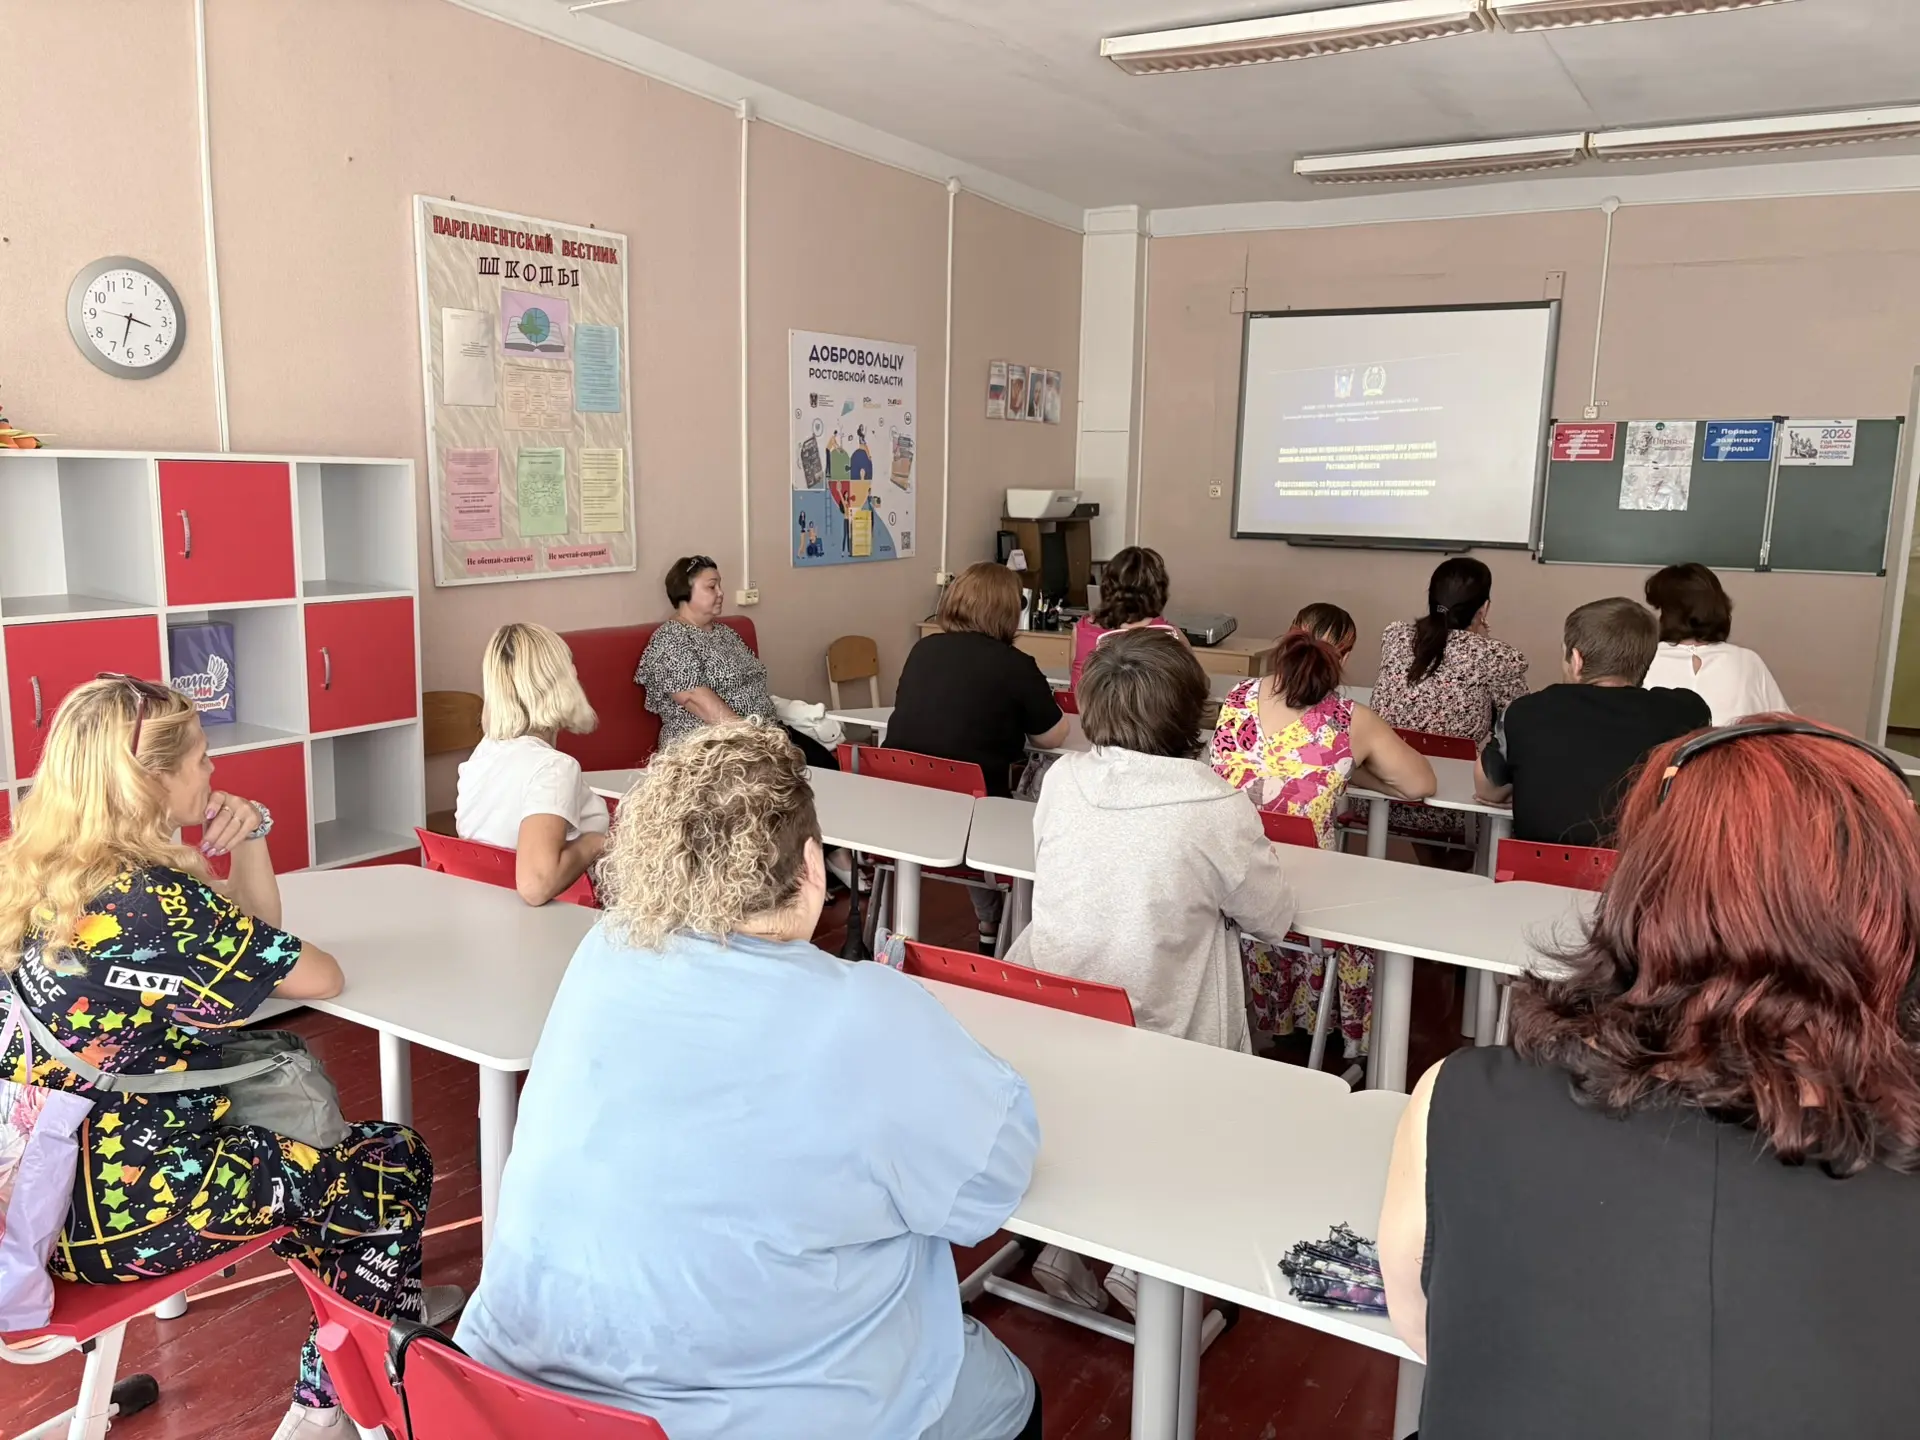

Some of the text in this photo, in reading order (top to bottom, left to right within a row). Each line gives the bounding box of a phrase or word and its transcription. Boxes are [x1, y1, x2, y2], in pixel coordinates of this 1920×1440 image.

[433, 215, 618, 264] ПАРЛАМЕНТСКИЙ ВЕСТНИК
[106, 280, 116, 292] 11
[122, 277, 134, 289] 12
[144, 285, 148, 296] 1
[94, 291, 106, 304] 10
[155, 299, 162, 310] 2
[88, 307, 97, 319] 9
[161, 316, 168, 327] 3
[95, 327, 104, 338] 8
[155, 333, 163, 344] 4
[109, 341, 117, 352] 7
[144, 345, 151, 356] 5
[126, 347, 134, 359] 6
[808, 344, 904, 371] ДОБРОВОЛЬЦУ
[809, 367, 903, 387] РОСТОВСКОЙ ОБЛАСТИ
[1821, 429, 1852, 439] 2026
[467, 557, 476, 566] Не
[25, 947, 67, 1002] DANCE
[18, 965, 47, 1007] WILDCAT
[361, 1247, 400, 1277] DANC
[355, 1264, 392, 1293] WILDCAT
